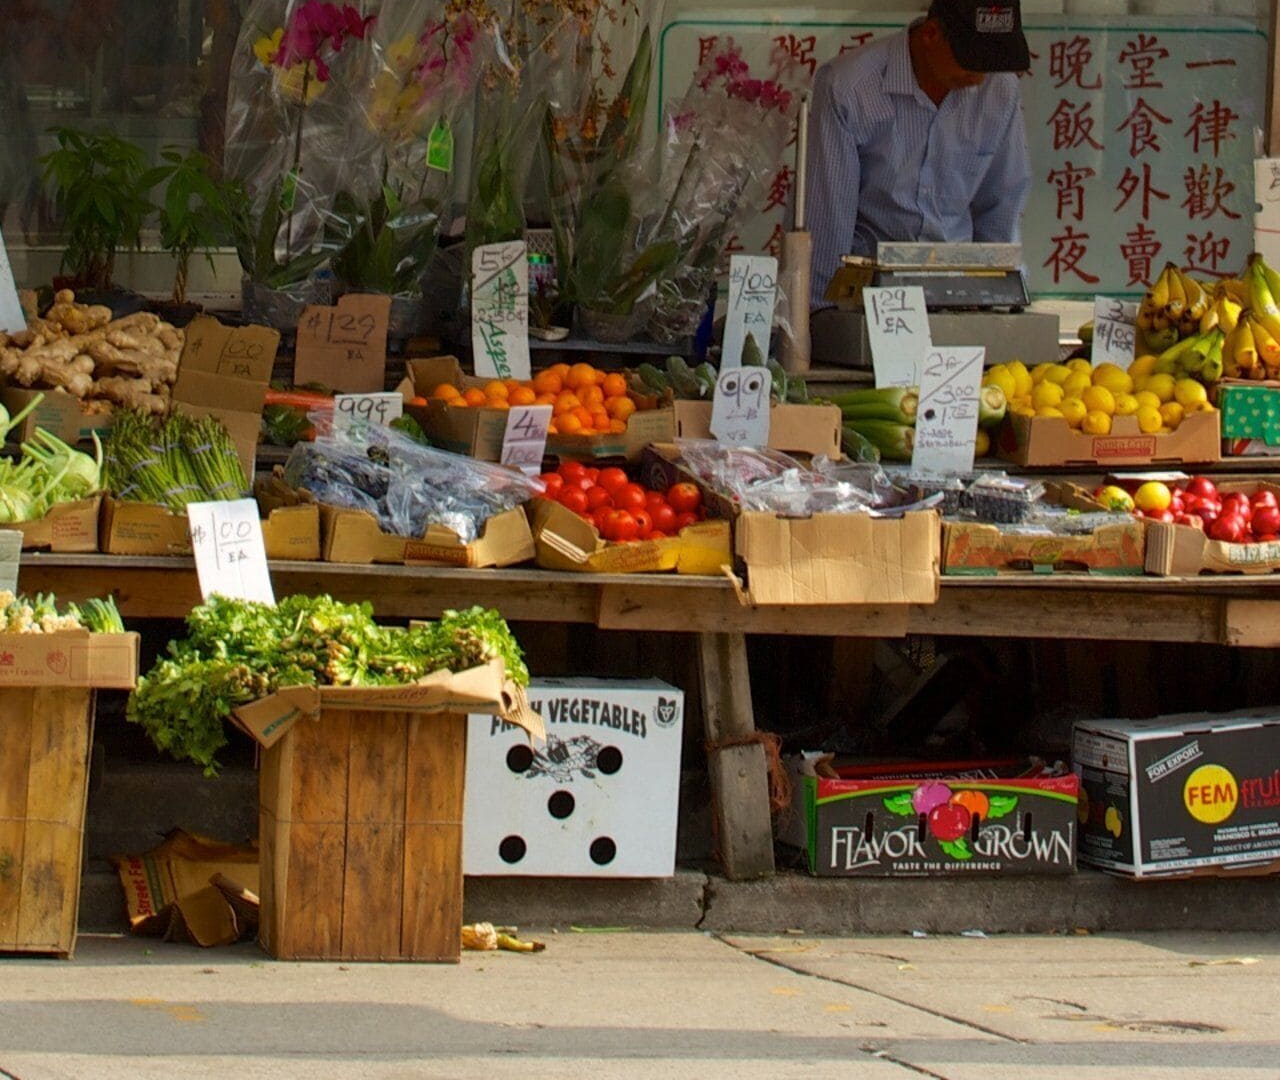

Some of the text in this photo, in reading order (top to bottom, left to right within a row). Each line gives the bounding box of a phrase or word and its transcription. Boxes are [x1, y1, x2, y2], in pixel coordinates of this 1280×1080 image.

[1042, 34, 1105, 283] 晚飯宵夜
[1113, 33, 1173, 288] 堂食外賣
[743, 311, 766, 325] EA
[923, 352, 944, 377] 2
[547, 697, 647, 739] VEGETABLES
[1147, 744, 1202, 780] FOR EXPORT
[1187, 782, 1235, 807] FEM
[830, 823, 928, 871] FLAVOR
[974, 820, 1074, 867] GROWN
[892, 861, 1002, 871] TASTE THE DIFFERENCE
